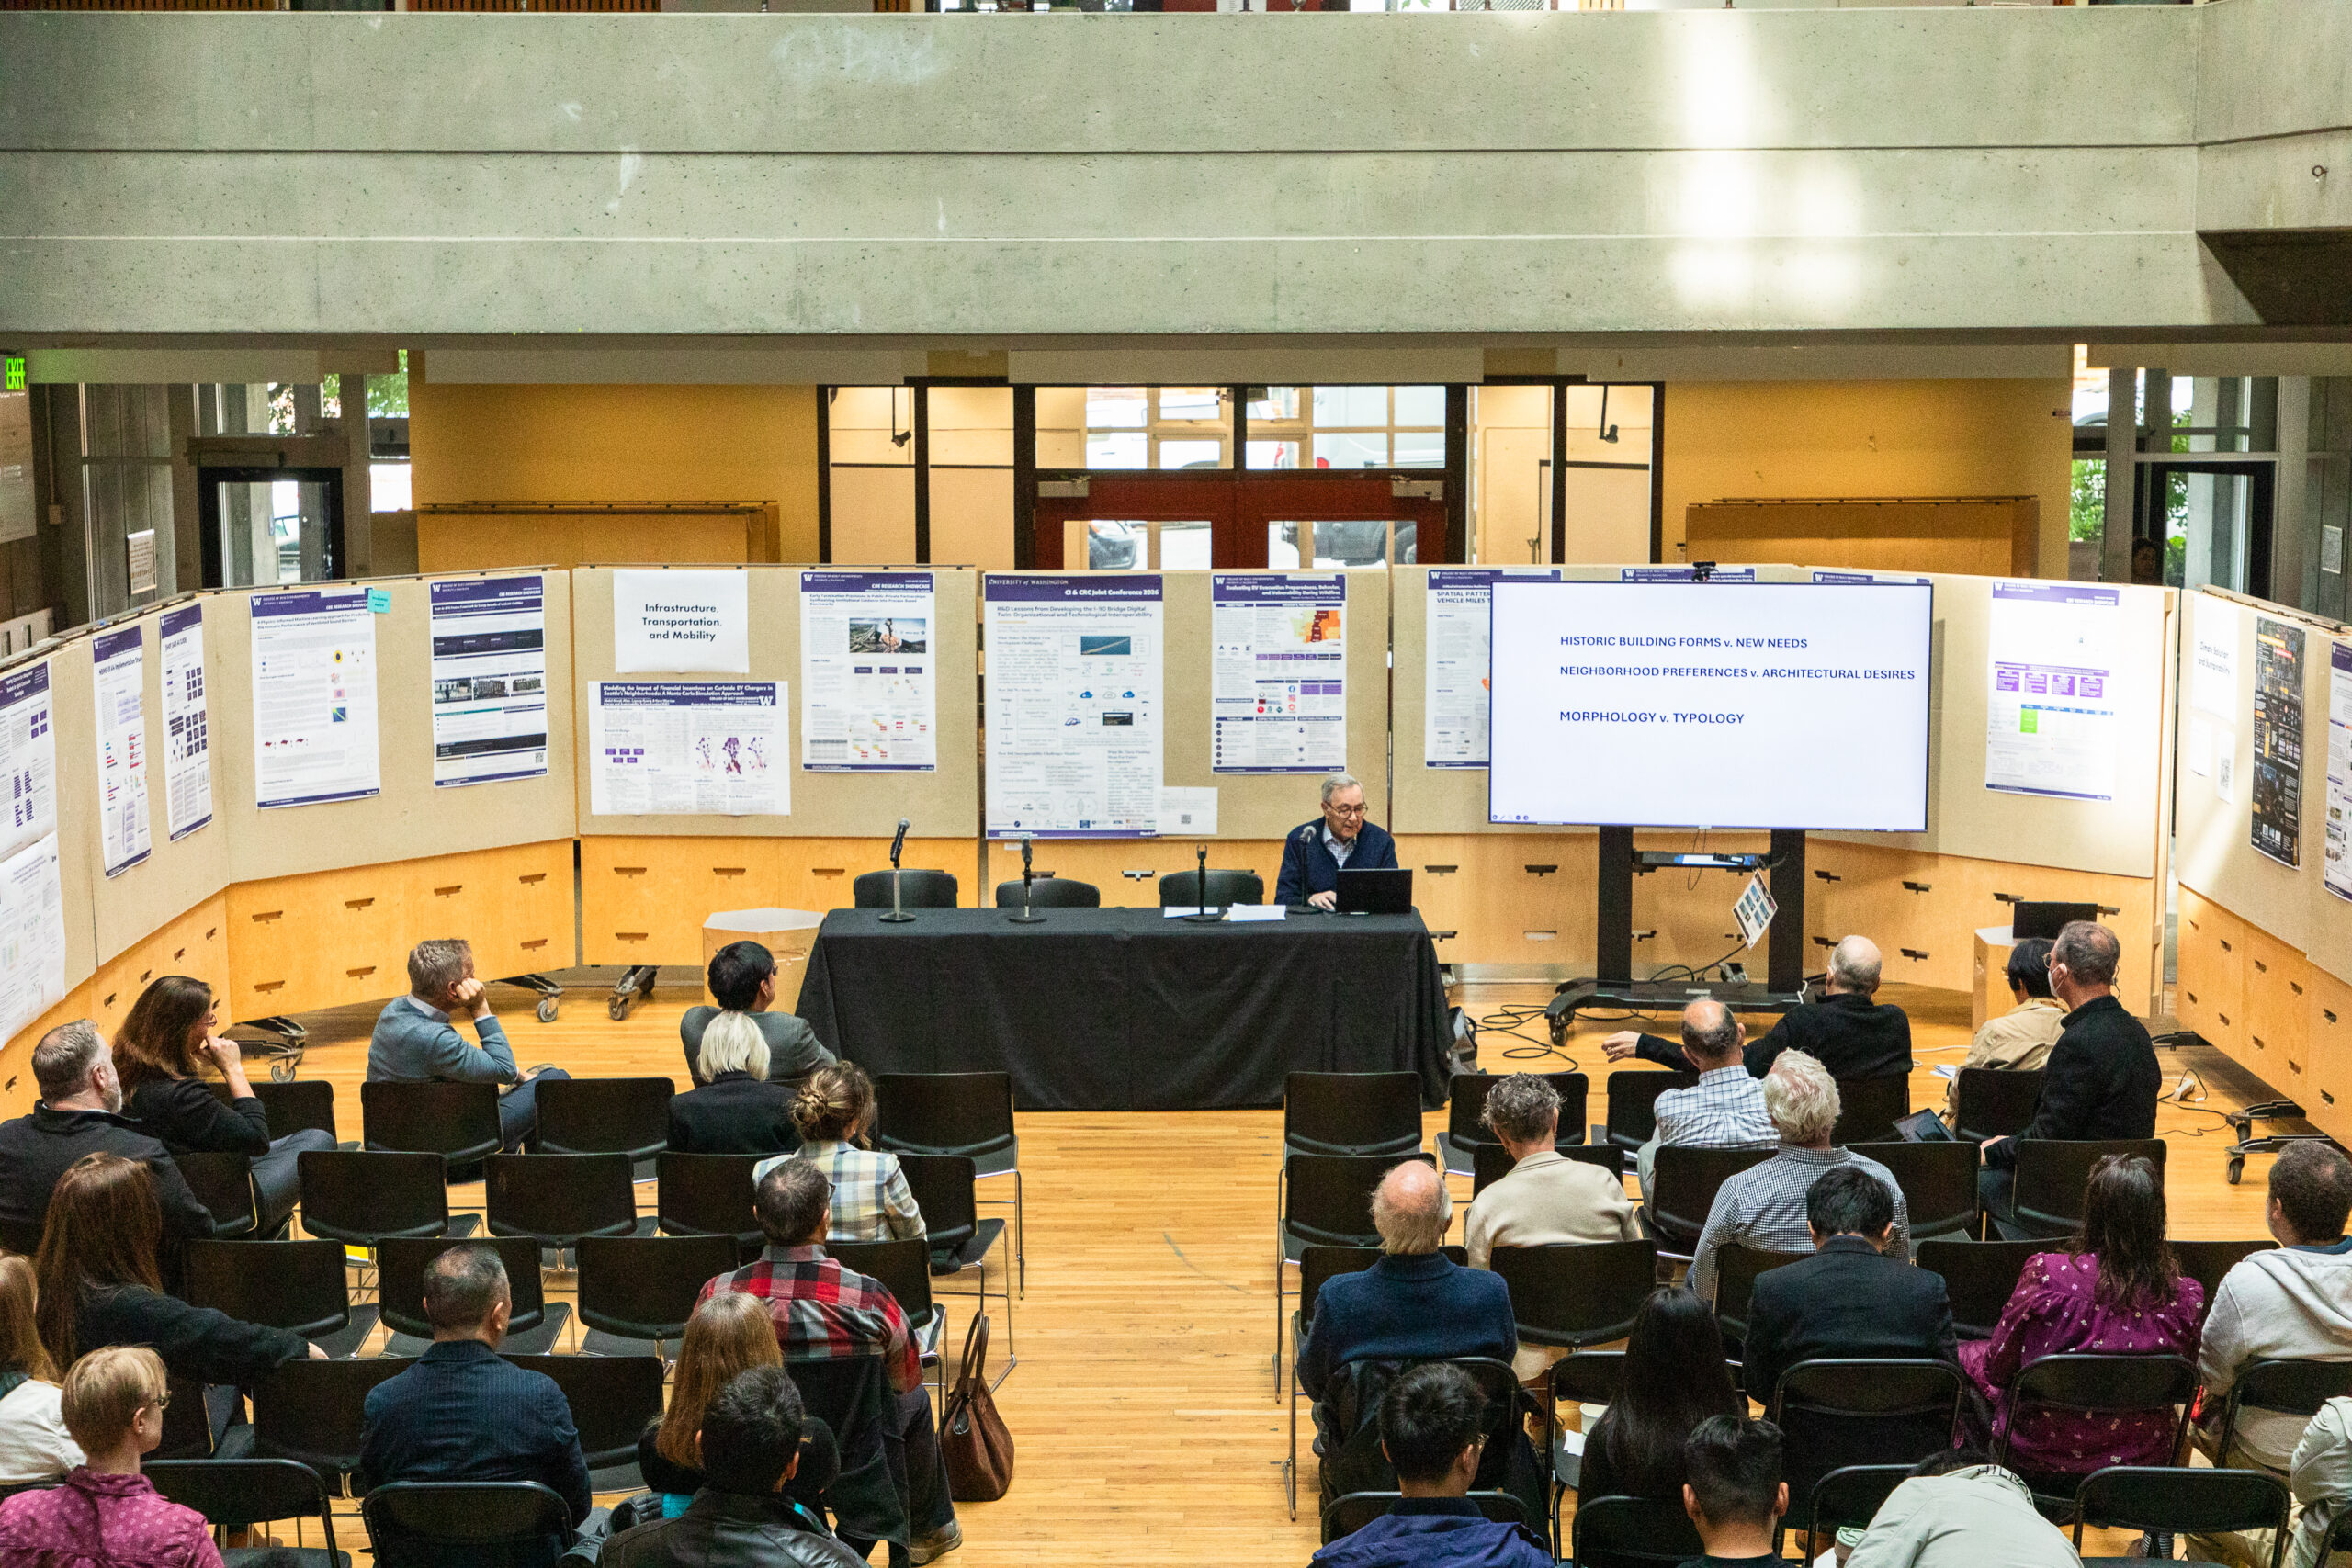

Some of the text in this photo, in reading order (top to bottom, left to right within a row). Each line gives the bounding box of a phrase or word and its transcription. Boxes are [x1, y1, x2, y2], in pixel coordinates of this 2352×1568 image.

[6, 357, 26, 390] EXIT
[645, 603, 718, 613] Infrastructure,
[642, 617, 722, 627] Transportation,
[650, 630, 716, 642] and Mobility
[1560, 637, 1808, 649] HISTORIC BUILDING FORMS v. NEW NEEDS
[1560, 666, 1659, 676] NEIGHBORHOOD
[1662, 668, 1747, 677] PREFERENCES
[1762, 669, 1861, 679] ARCHITECTURAL
[1863, 670, 1916, 680] DESIRES
[1559, 711, 1745, 724] MORPHOLOGY v. TYPOLOGY
